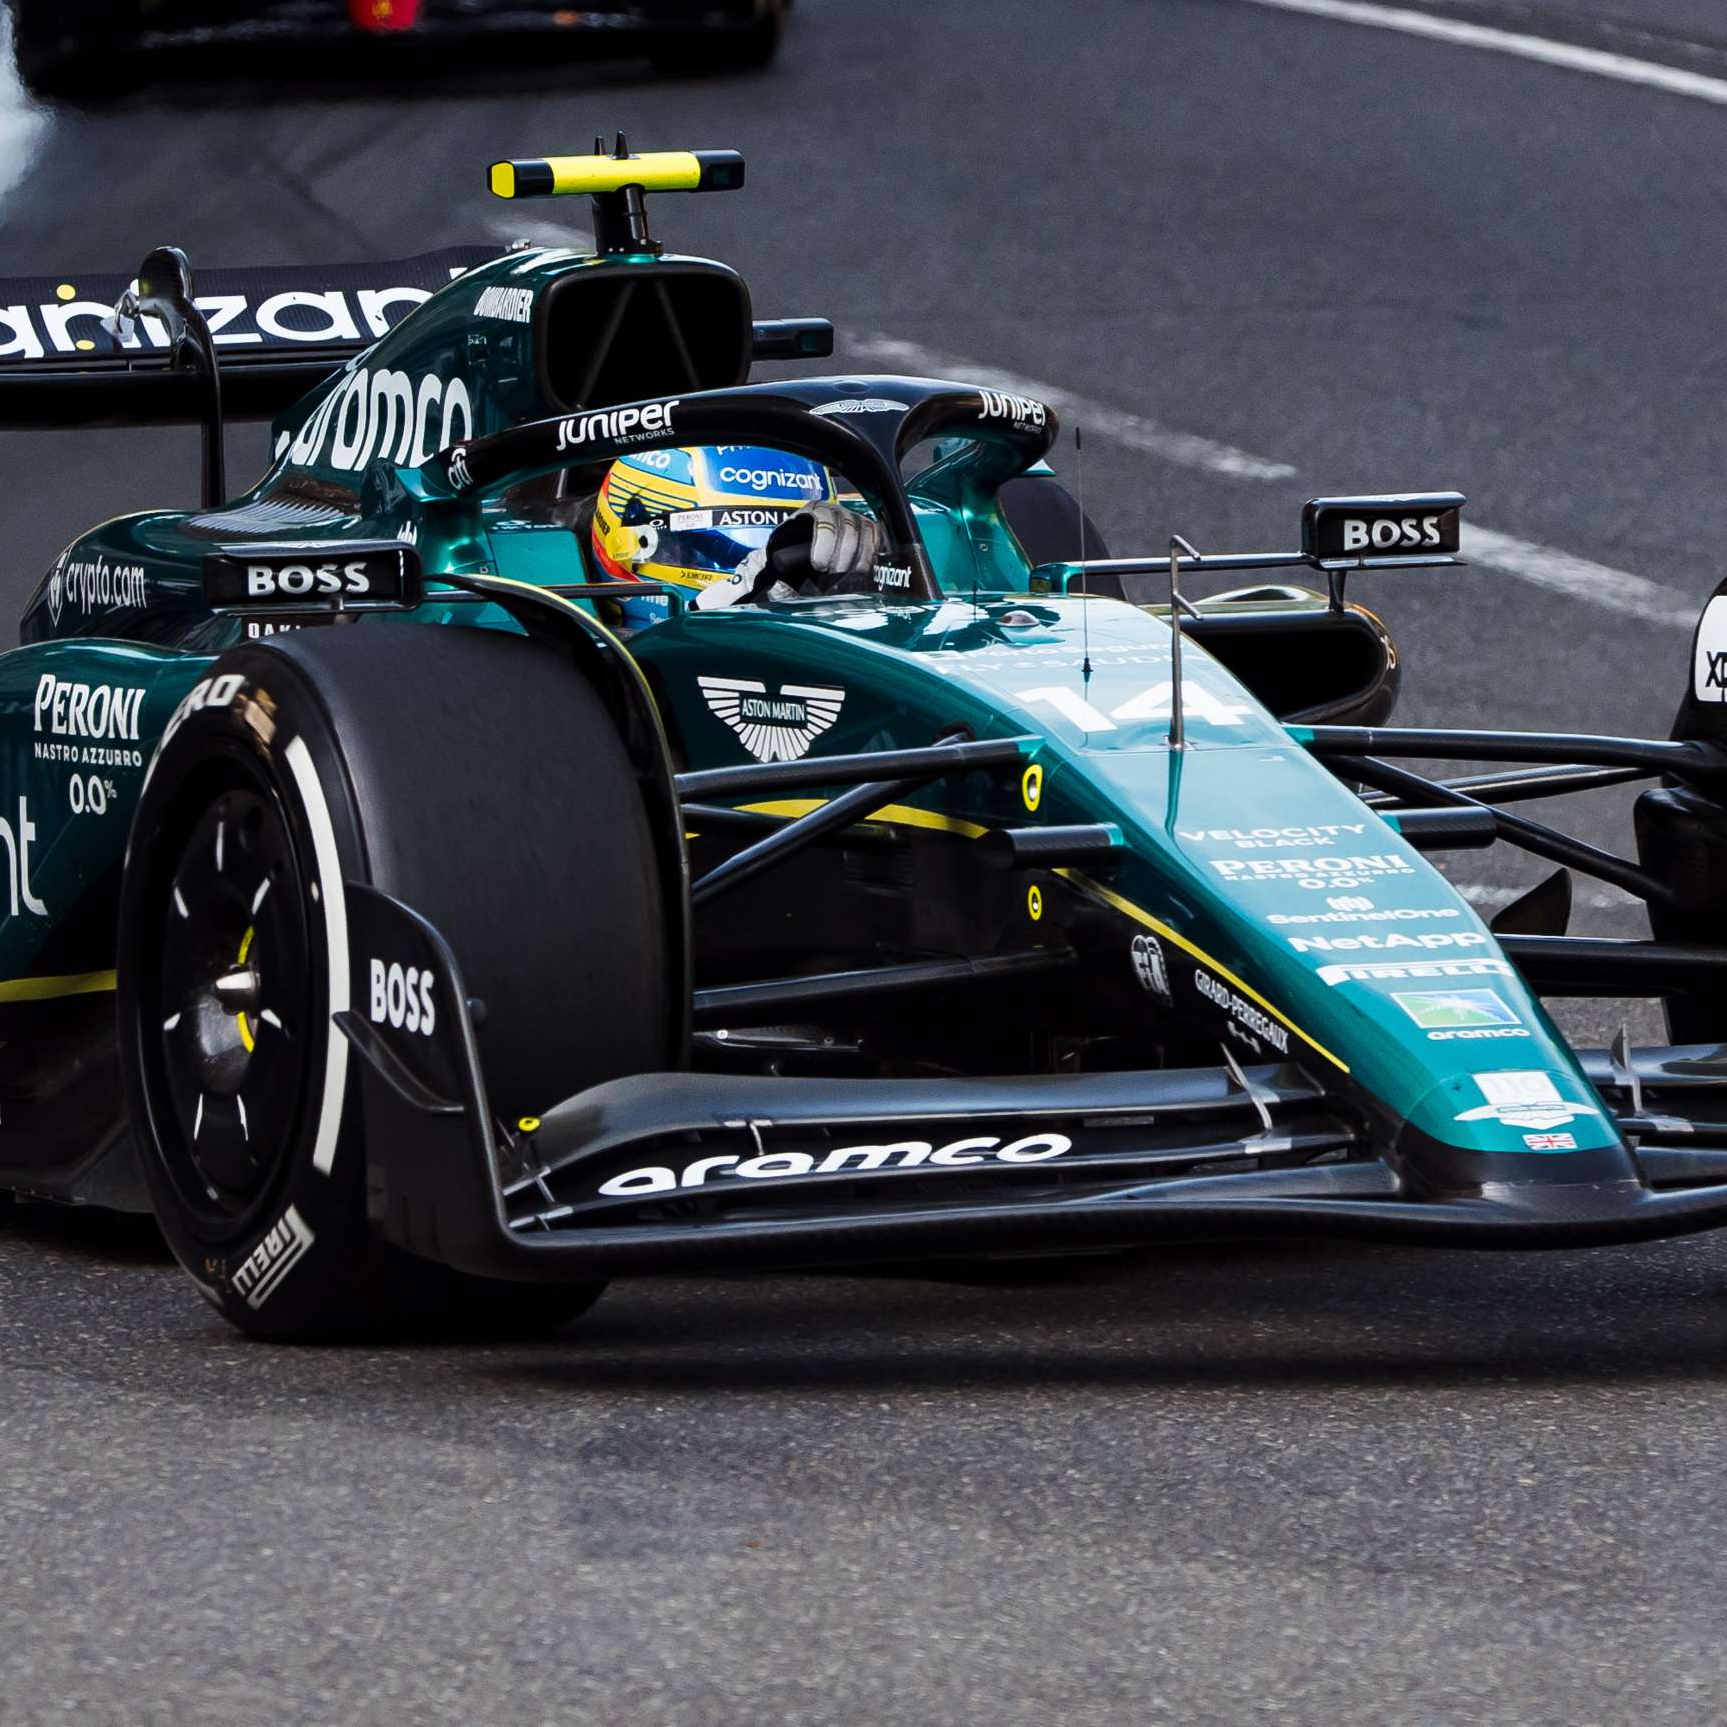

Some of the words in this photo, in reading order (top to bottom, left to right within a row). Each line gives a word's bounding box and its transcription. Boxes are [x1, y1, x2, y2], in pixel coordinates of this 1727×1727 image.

[474, 286, 534, 324] BOMBARDIER
[614, 427, 675, 446] NETWORKS
[719, 466, 824, 491] cognizant
[719, 510, 779, 526] ASTON
[1343, 516, 1441, 552] BOSS
[66, 554, 147, 615] crypto.com
[247, 561, 370, 597] BOSS
[34, 674, 147, 740] PERONI
[741, 698, 771, 718] ASTON
[773, 701, 805, 721] MARTIN
[1014, 680, 1257, 733] 14
[34, 742, 79, 763] NASTRO
[81, 747, 143, 767] AZZURRO
[69, 773, 118, 815] 0.0%
[1178, 824, 1365, 842] VELOCITY
[1234, 836, 1336, 849] BLACK
[1209, 854, 1411, 876] PERONI
[1297, 877, 1375, 889] 0.0%
[1266, 908, 1461, 925] SentinelOne
[1288, 932, 1487, 953] NetApp
[1315, 958, 1515, 987] PIRELLI
[370, 958, 435, 1037] BOSS
[1194, 968, 1289, 1055] GIRARD-PERREGAUX
[1427, 1027, 1531, 1041] aramco
[598, 1133, 1073, 1197] aramco
[231, 1202, 315, 1311] PIRELLI
